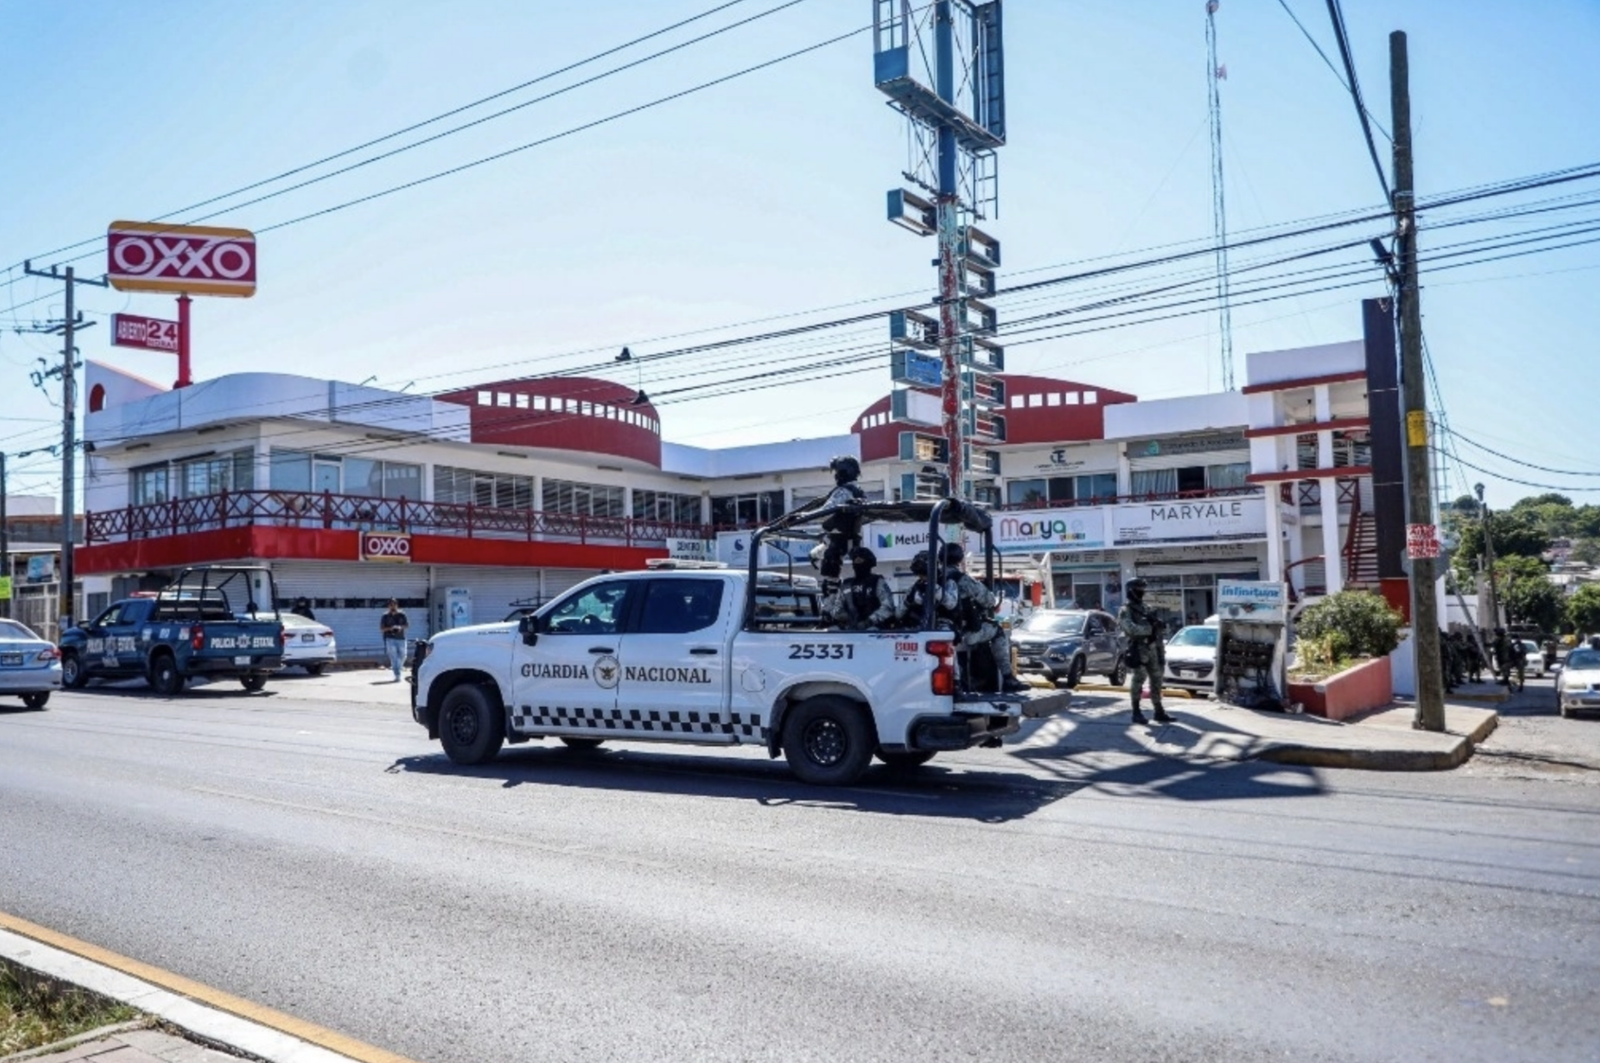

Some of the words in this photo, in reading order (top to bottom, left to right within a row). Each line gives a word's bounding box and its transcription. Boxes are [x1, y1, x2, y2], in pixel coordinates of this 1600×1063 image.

[113, 236, 251, 279] OXXO
[148, 321, 177, 341] 24
[1151, 502, 1242, 521] MARYALE
[1000, 518, 1067, 539] Marya
[368, 537, 410, 555] OXXO
[895, 532, 931, 545] MetLif
[210, 637, 235, 649] POLICIA
[252, 637, 275, 648] ESTATAL
[788, 644, 854, 660] 25331
[520, 663, 589, 680] GUARDIA
[625, 666, 712, 684] NACIONAL
